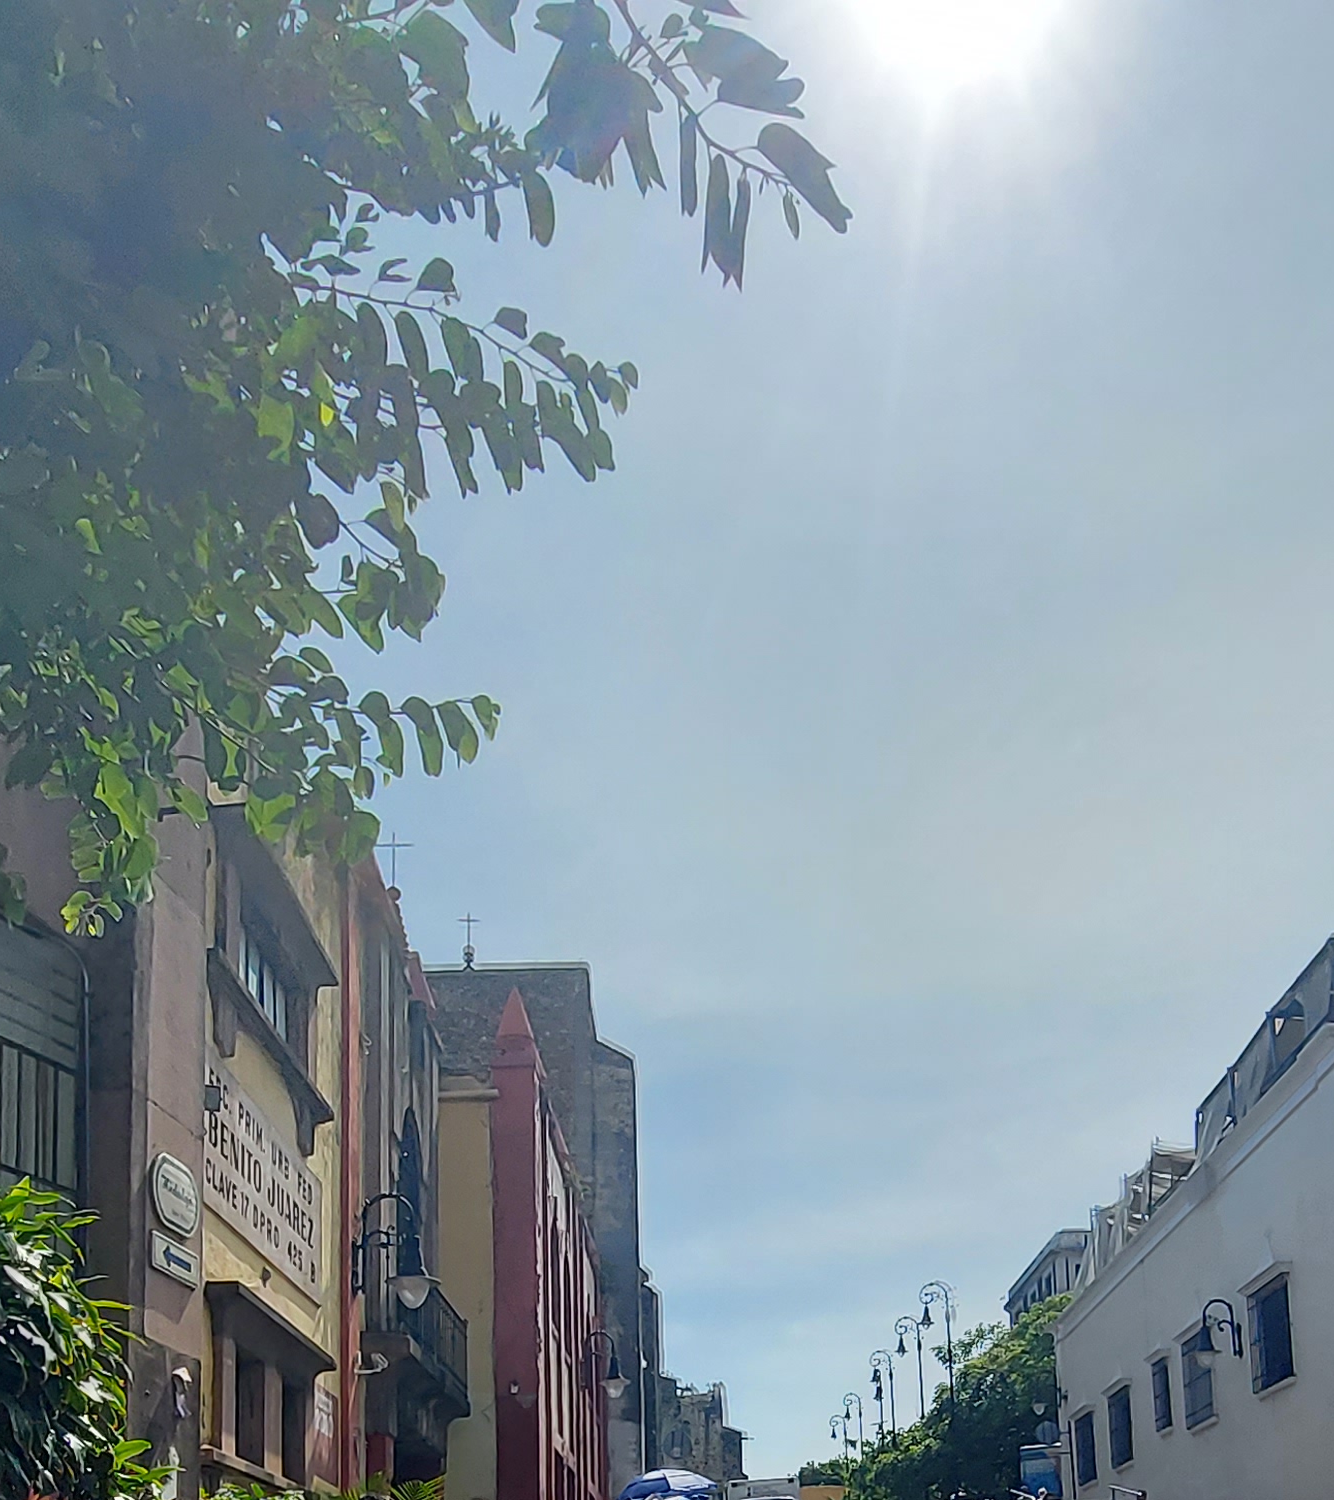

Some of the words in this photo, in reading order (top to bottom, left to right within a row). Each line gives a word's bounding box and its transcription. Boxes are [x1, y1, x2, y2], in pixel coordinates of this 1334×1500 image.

[208, 1111, 263, 1194] BENITO
[267, 1176, 315, 1249] JUAREZ
[237, 1101, 266, 1154] PRIM.
[270, 1141, 290, 1181] URB
[297, 1170, 313, 1206] FED
[205, 1157, 238, 1210] CLAVE
[240, 1191, 250, 1219] 17
[287, 1240, 303, 1272] 425
